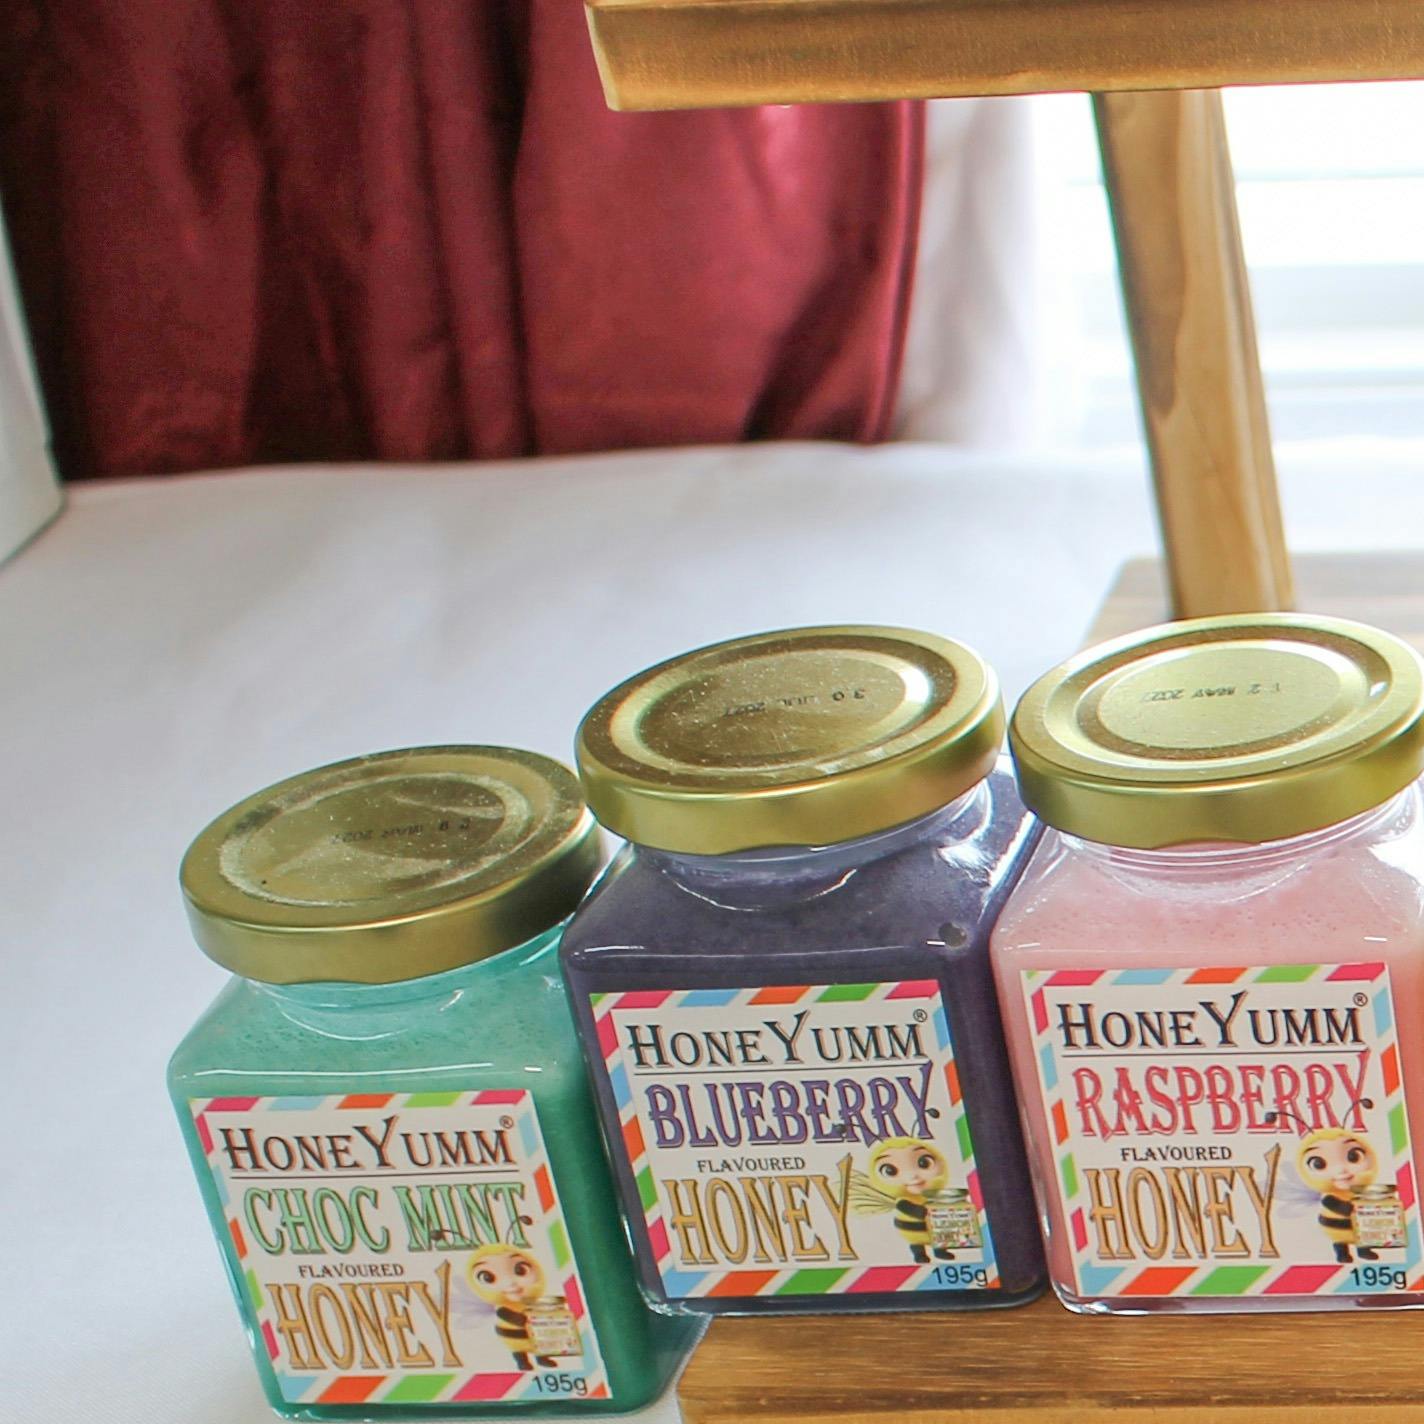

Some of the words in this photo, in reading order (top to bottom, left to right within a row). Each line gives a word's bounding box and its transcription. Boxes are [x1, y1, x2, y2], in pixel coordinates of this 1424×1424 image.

[644, 1063, 939, 1149] BLUEBERRY
[1073, 1051, 1372, 1138] RASPBERRY
[697, 1158, 805, 1173] FLAVOURED
[1120, 1146, 1232, 1161] FLAVOURED
[243, 1186, 391, 1256] CHOC
[400, 1182, 531, 1253] MINT
[665, 1153, 859, 1266] HONEY
[1084, 1144, 1282, 1262] HONEY
[298, 1264, 404, 1279] FLAVOURED
[931, 1266, 989, 1290] 195g
[1350, 1268, 1407, 1290] 195g
[265, 1260, 461, 1373] HONEY
[531, 1374, 589, 1398] 195g
